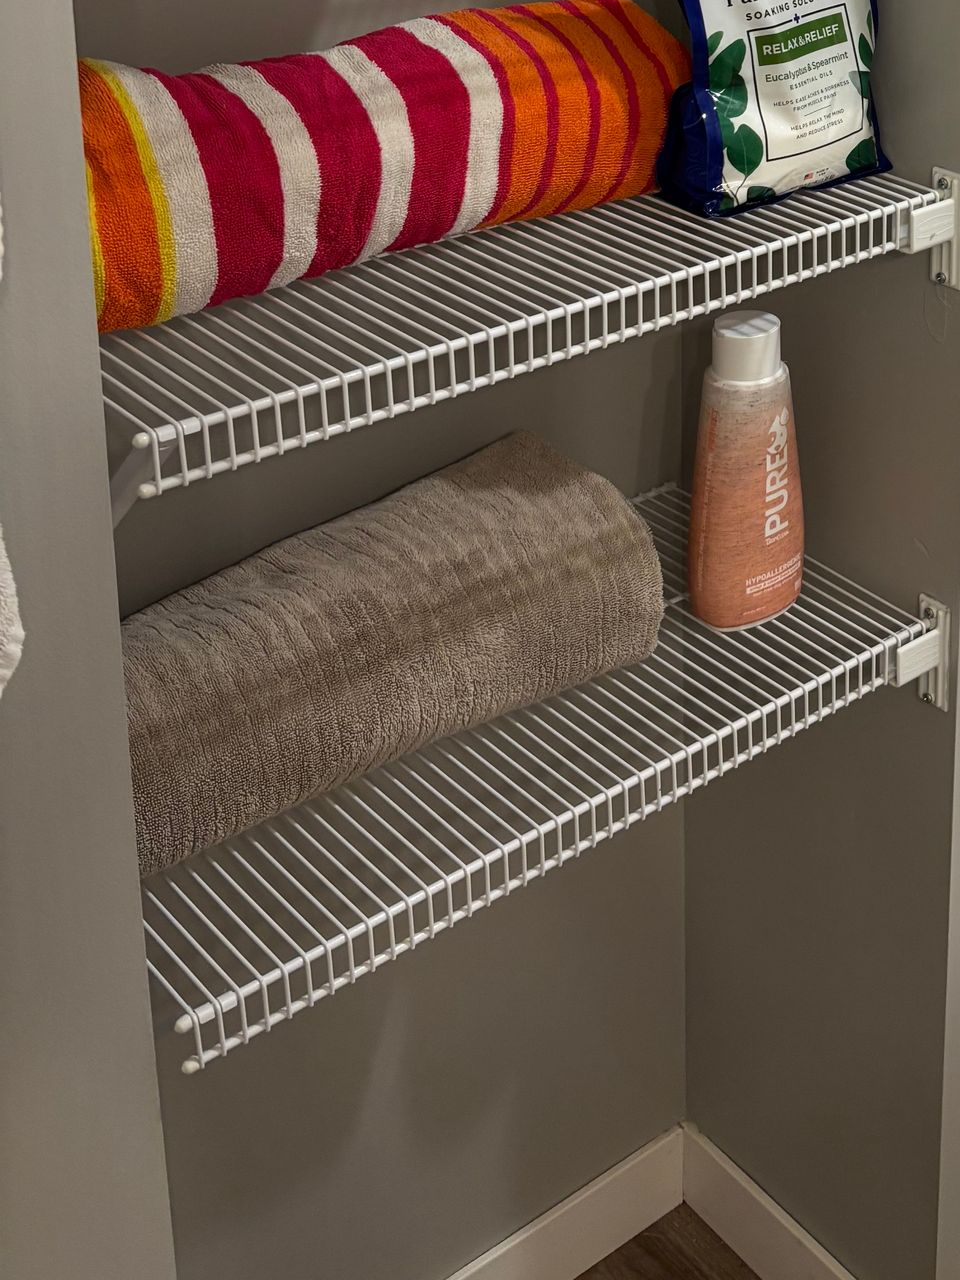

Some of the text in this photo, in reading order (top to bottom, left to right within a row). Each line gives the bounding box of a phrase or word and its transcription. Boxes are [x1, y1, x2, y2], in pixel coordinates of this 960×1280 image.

[746, 2, 790, 21] SOAKING
[789, 69, 833, 91] ESSENTIAL OILS
[764, 449, 789, 539] PURE
